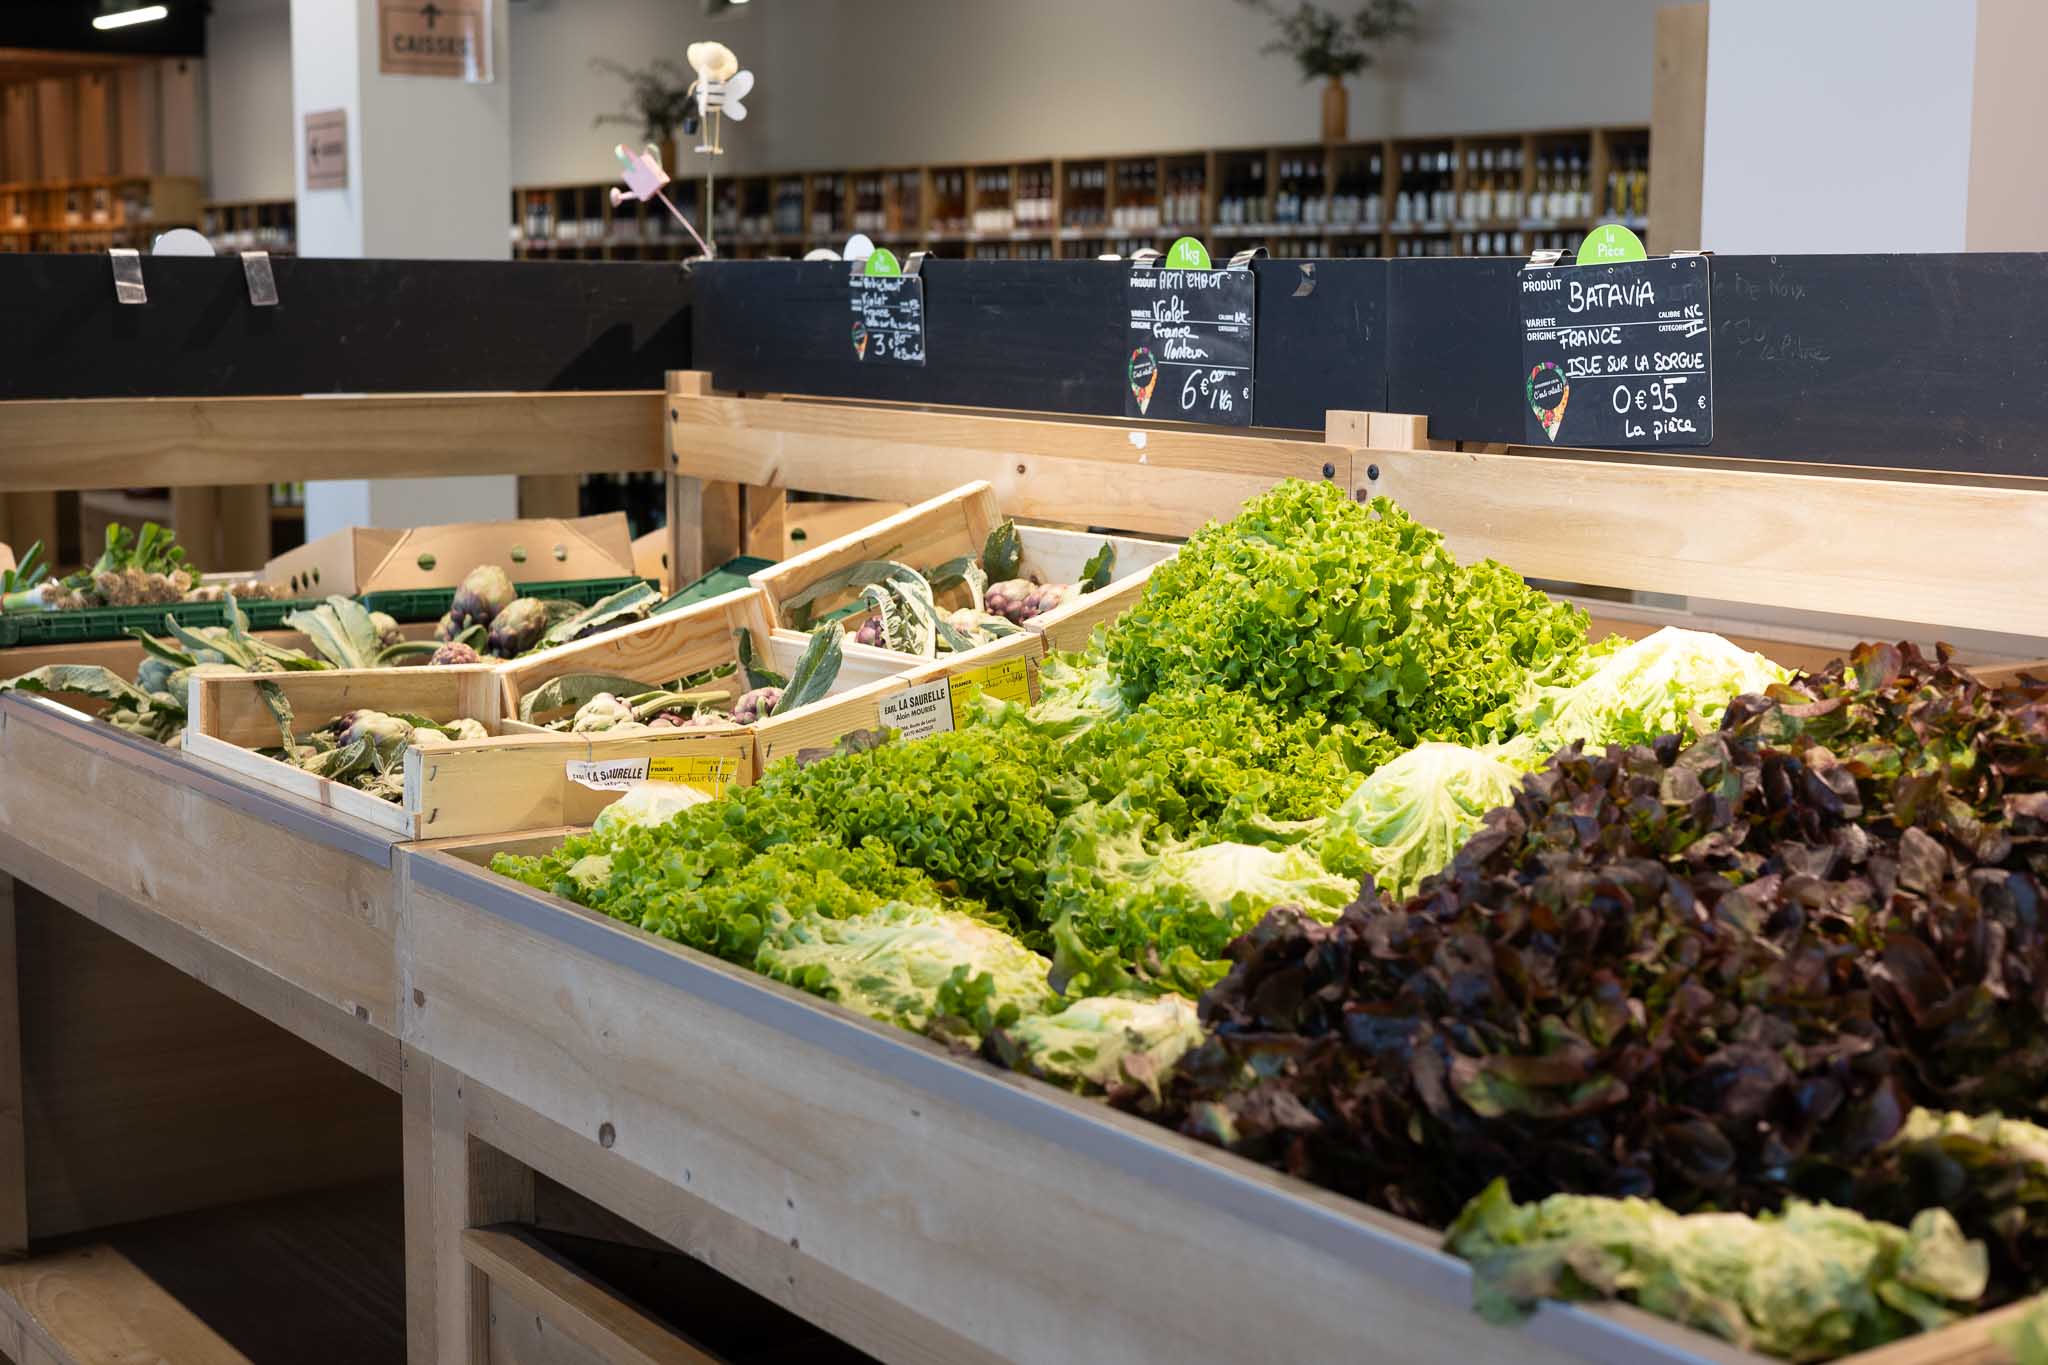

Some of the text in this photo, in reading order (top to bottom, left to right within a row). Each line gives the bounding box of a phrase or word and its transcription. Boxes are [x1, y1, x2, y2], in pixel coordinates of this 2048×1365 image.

[1179, 241, 1200, 266] 1kg
[1130, 277, 1157, 288] PRODUIT
[1522, 279, 1562, 293] PRODUIT
[1152, 295, 1190, 324] Violet
[1525, 303, 1704, 328] VARIETE CALIBRE NC
[1153, 322, 1200, 340] France
[1526, 331, 1557, 341] ORIGINE
[1557, 326, 1623, 350] FRANCE
[1607, 355, 1629, 373] SUR
[1634, 356, 1650, 372] LA
[1653, 352, 1705, 371] SORGUE
[1697, 395, 1706, 409] €
[1625, 417, 1697, 440] La pièce
[899, 698, 909, 711] LA
[909, 688, 946, 708] SAURELLE
